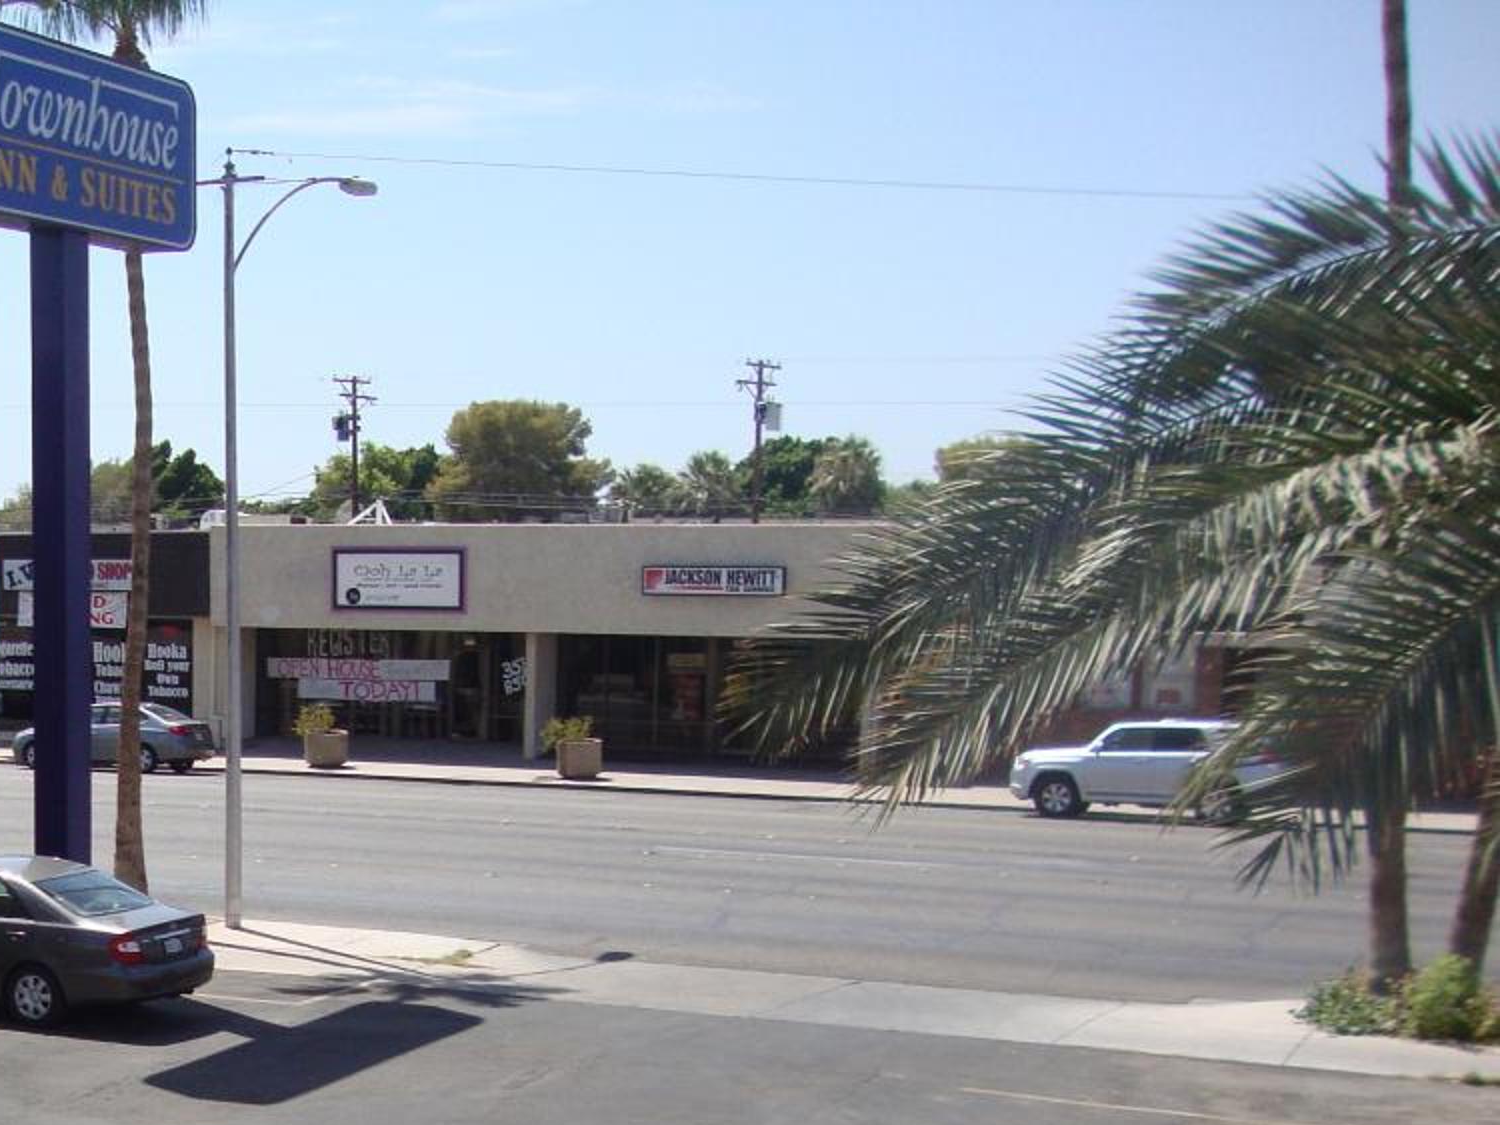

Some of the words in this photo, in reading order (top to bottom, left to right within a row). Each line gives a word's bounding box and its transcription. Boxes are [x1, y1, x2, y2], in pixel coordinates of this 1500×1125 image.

[52, 165, 69, 201] &
[80, 168, 175, 224] SUITES
[665, 570, 721, 584] JACKSON
[726, 570, 775, 585] HEWITT
[327, 660, 381, 680] HOUSE
